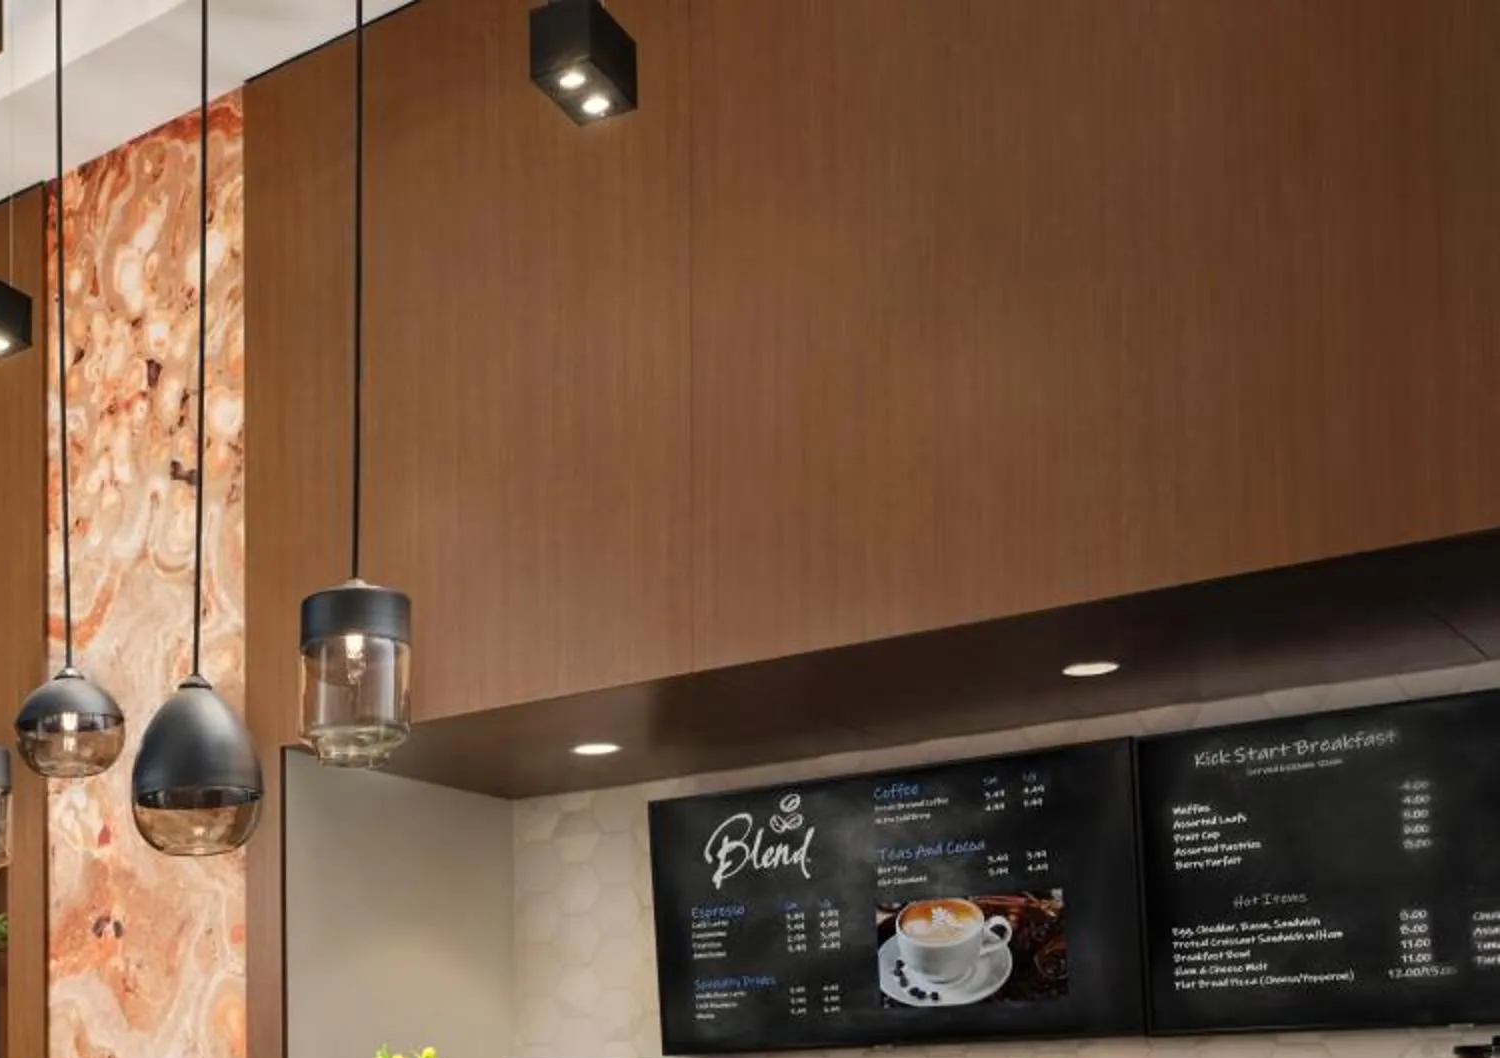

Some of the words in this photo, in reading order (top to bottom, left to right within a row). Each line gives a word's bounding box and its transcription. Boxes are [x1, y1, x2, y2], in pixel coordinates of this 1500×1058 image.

[1194, 752, 1230, 768] Kick
[1234, 744, 1290, 764] Start
[1293, 730, 1397, 756] Breakfast
[873, 783, 919, 800] Coffee
[703, 811, 815, 890] Blend
[915, 844, 942, 859] And
[1233, 895, 1259, 909] Hot
[1261, 892, 1308, 905] Items
